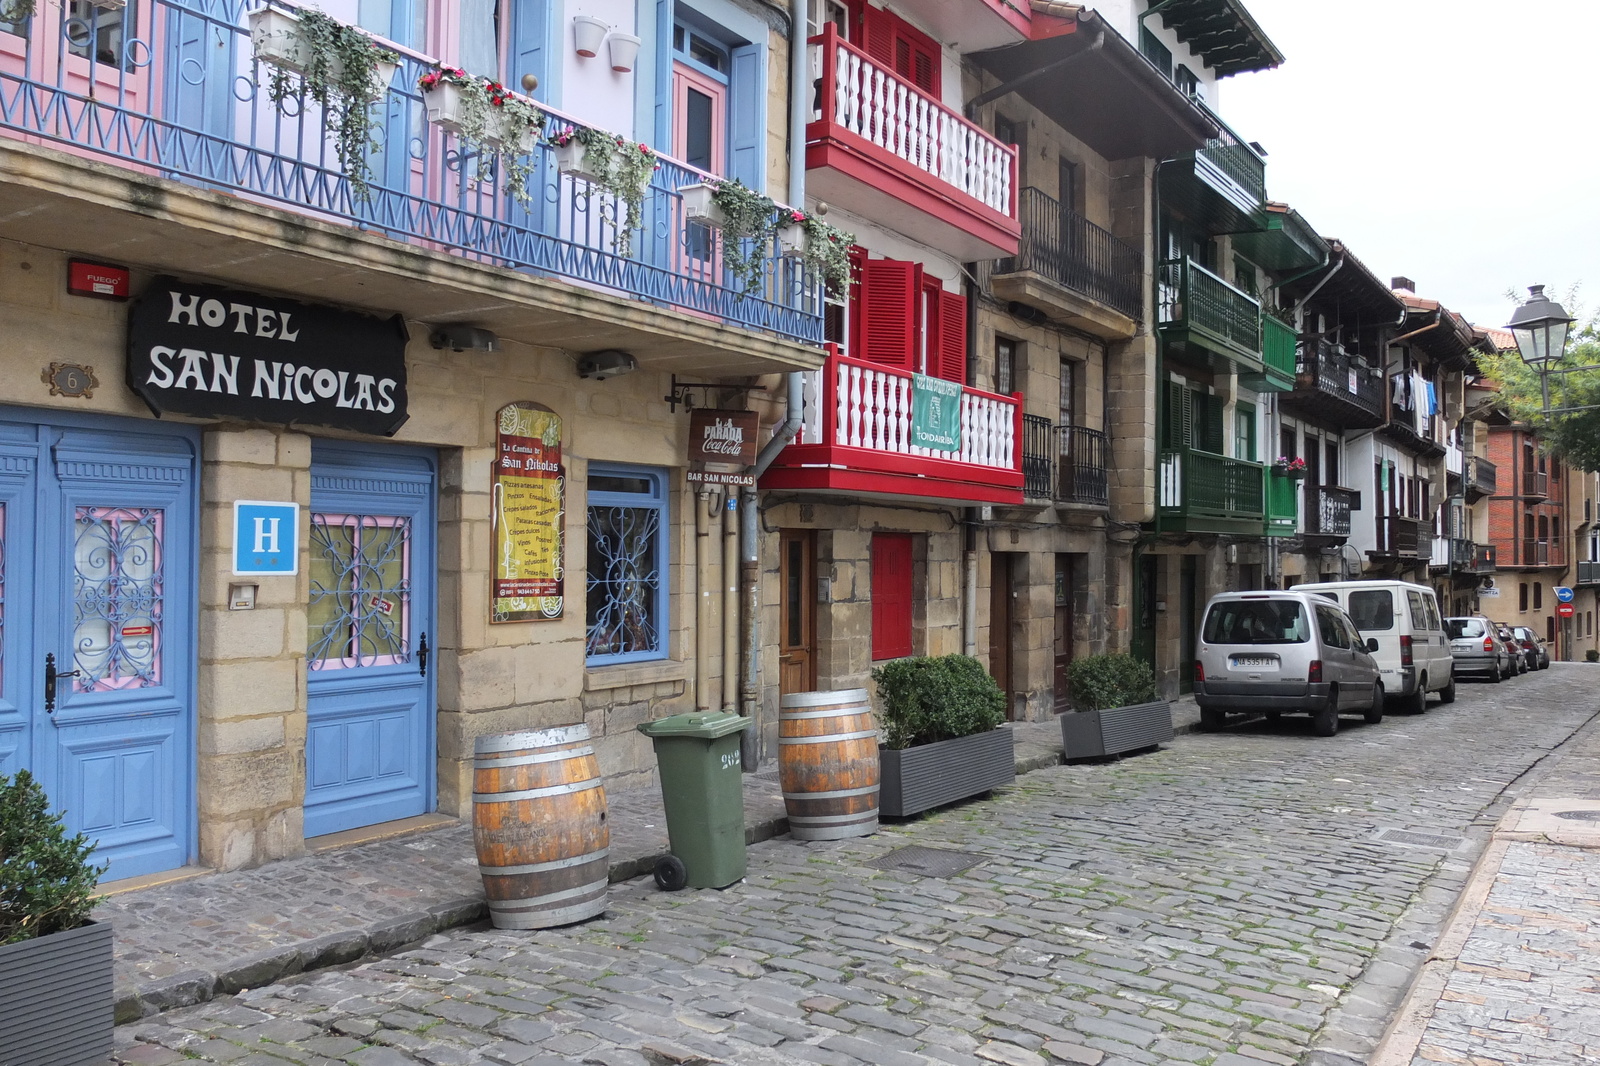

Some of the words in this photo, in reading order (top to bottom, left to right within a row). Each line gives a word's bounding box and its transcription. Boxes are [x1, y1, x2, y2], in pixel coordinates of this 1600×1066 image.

[87, 275, 119, 284] FUEGO
[168, 291, 300, 342] HOTEL
[146, 345, 241, 396] SAN
[67, 372, 77, 389] 6
[703, 425, 743, 442] PARADA
[502, 443, 511, 452] La
[512, 445, 533, 454] Cantina
[702, 438, 744, 455] Coca-Cola
[502, 455, 522, 469] San
[524, 457, 559, 472] Nikolas
[687, 472, 702, 481] BAR
[704, 473, 719, 482] SAN
[720, 475, 754, 485] NICOLAS
[252, 517, 281, 553] H
